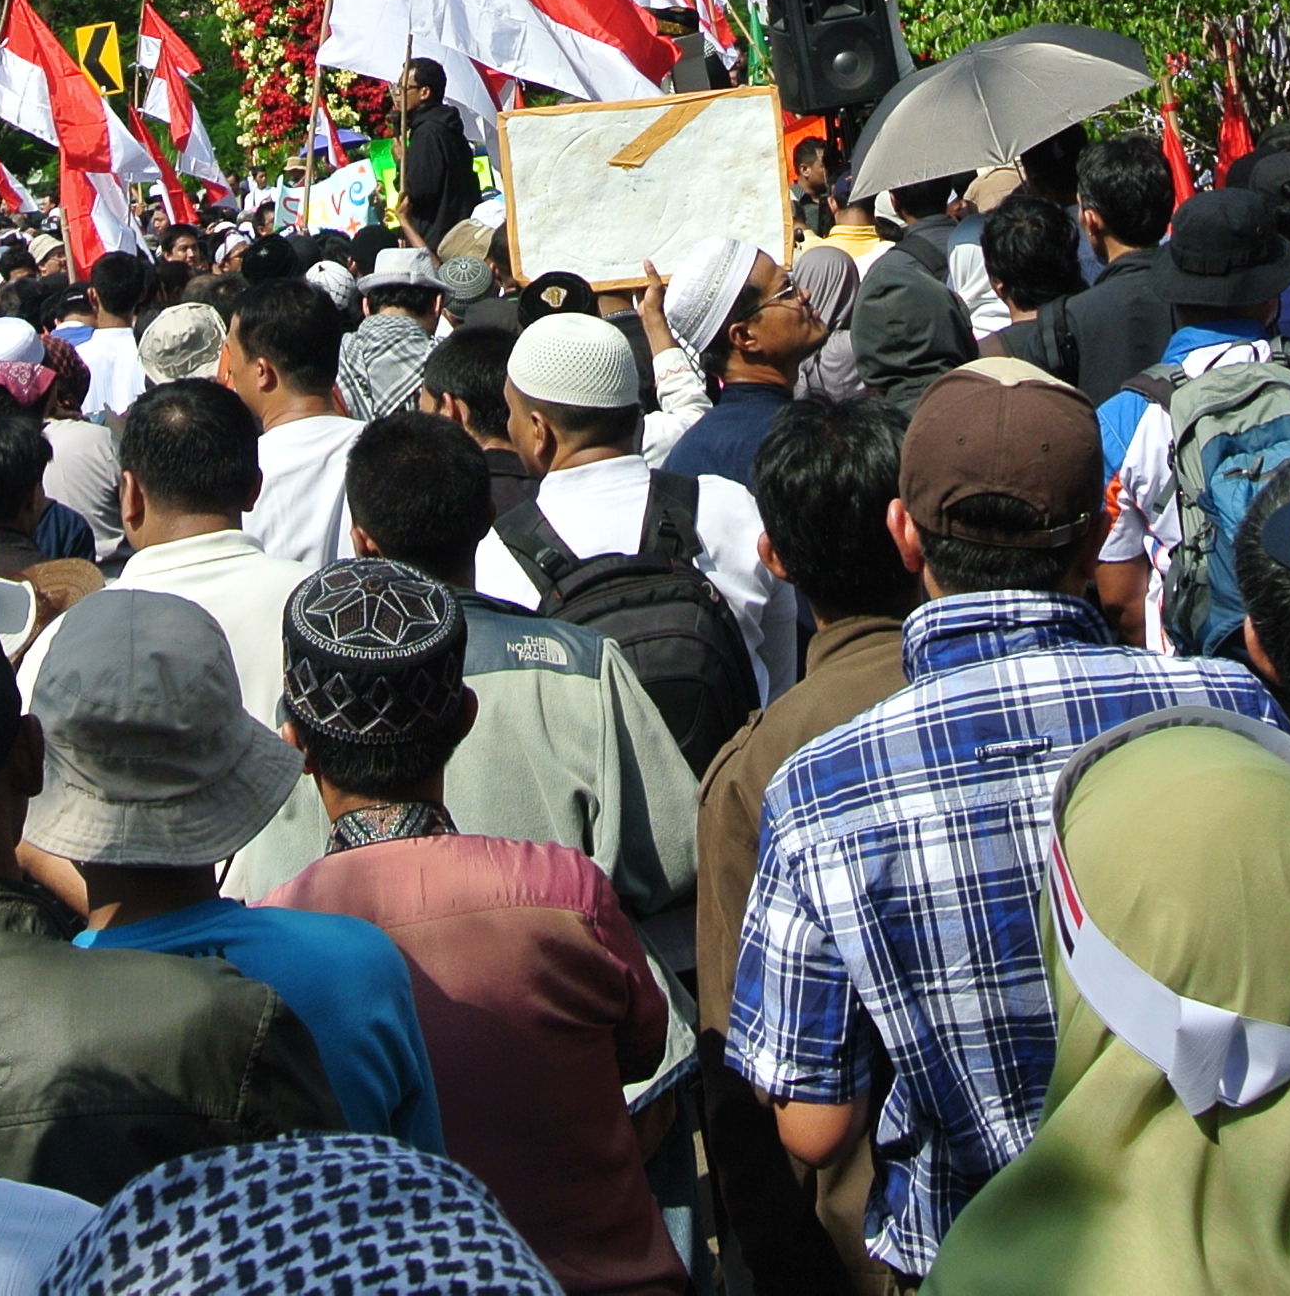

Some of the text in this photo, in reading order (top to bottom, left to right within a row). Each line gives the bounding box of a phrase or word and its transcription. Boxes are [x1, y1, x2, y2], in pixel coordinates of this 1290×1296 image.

[522, 635, 546, 645] THE
[506, 642, 546, 653] NORTH
[518, 651, 547, 662] FACE
